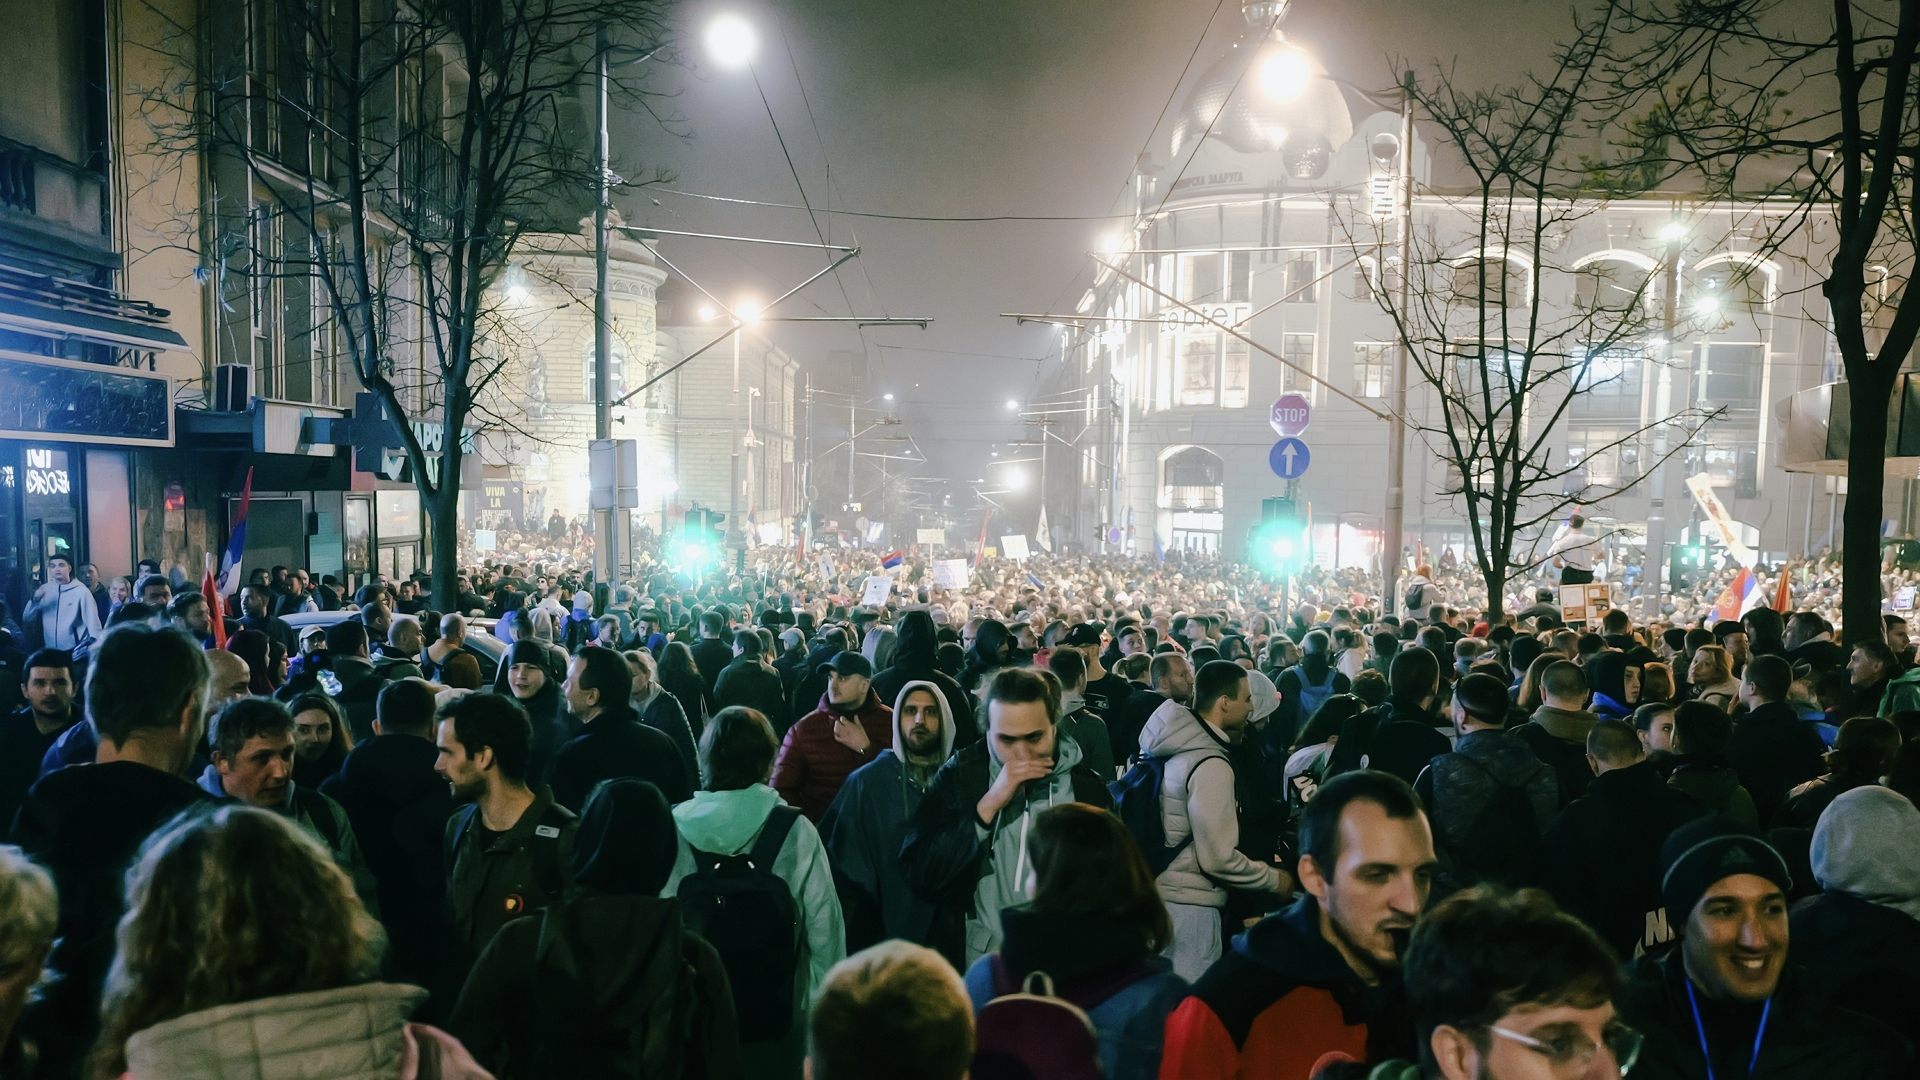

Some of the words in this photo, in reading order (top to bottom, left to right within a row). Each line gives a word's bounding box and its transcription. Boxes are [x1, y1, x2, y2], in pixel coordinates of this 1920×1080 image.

[1275, 407, 1307, 422] STOP
[485, 486, 506, 497] VIVA
[490, 497, 502, 508] LA
